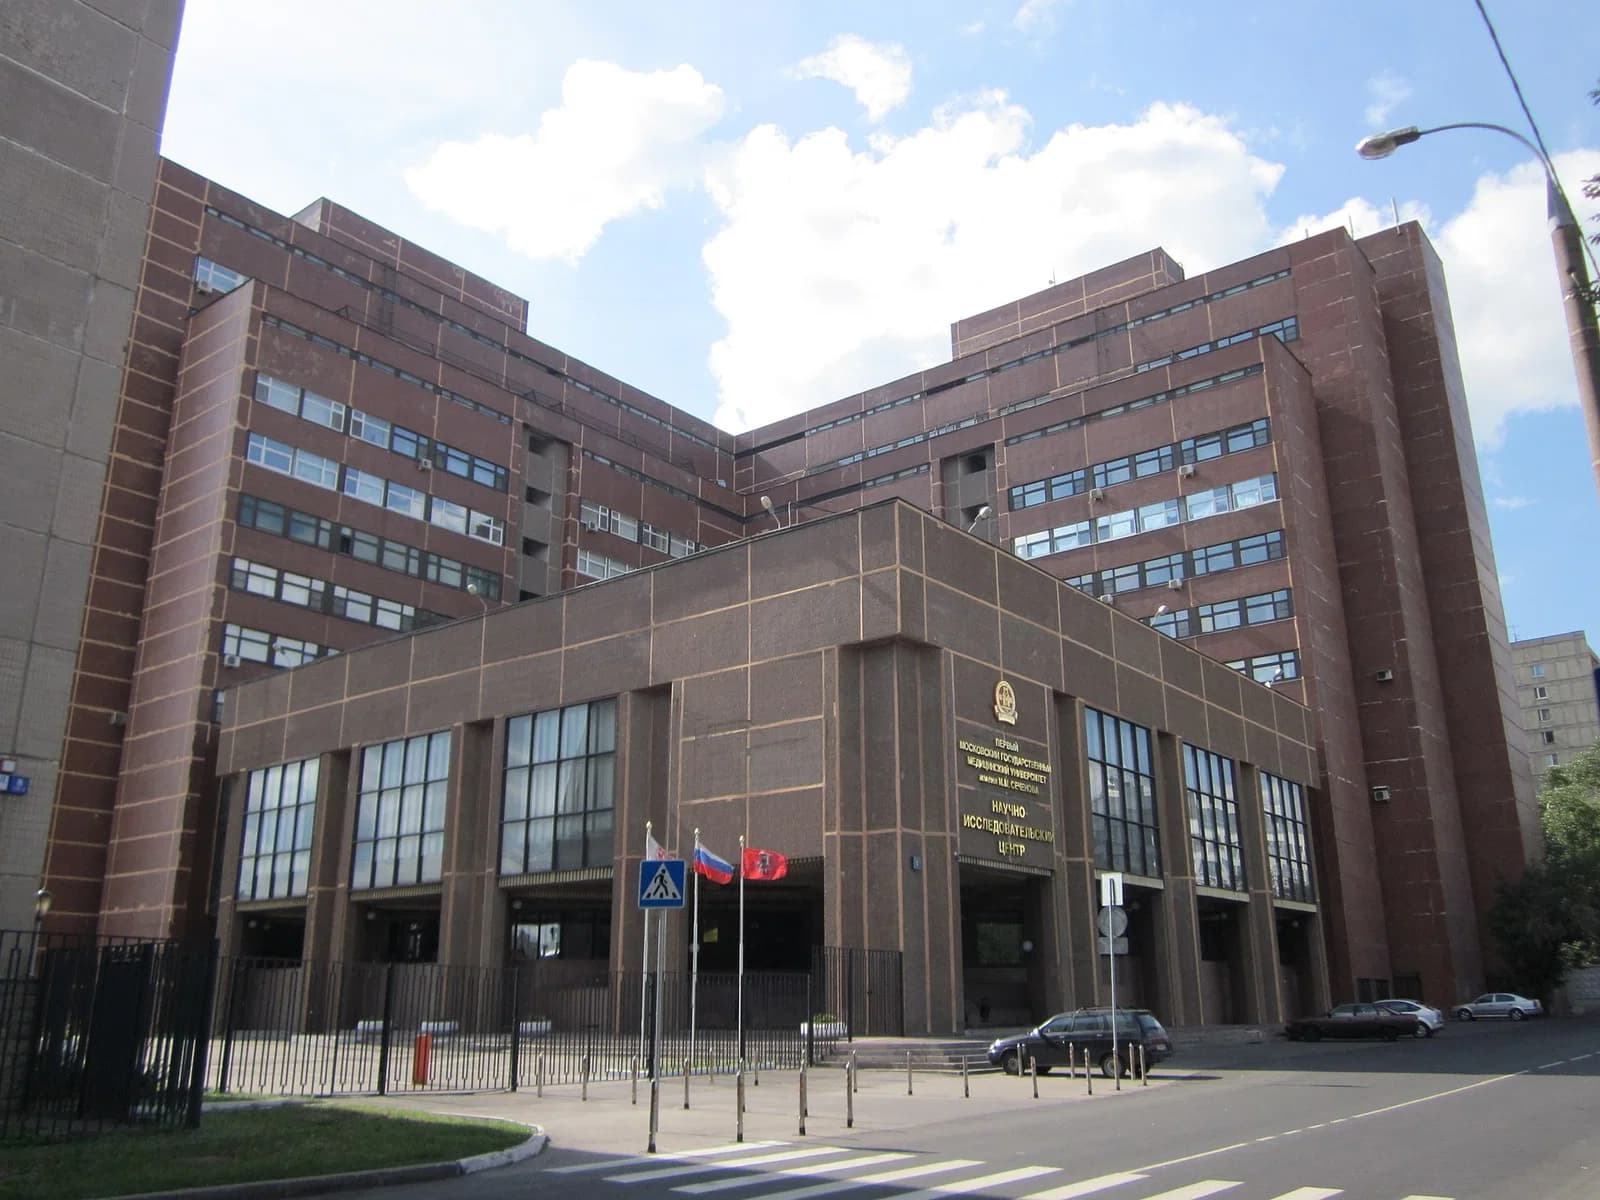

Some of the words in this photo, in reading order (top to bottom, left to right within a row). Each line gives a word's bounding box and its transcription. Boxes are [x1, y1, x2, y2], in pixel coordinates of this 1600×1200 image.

[995, 738, 1018, 752] ПЕРВЫЙ
[968, 756, 1009, 776] МЕДИЦИНСКИЙ
[1010, 767, 1046, 784] УНИВЕРСИТЕТ
[1010, 780, 1039, 794] СЕЧЕНОВА
[998, 840, 1026, 856] ЦЕНТР
